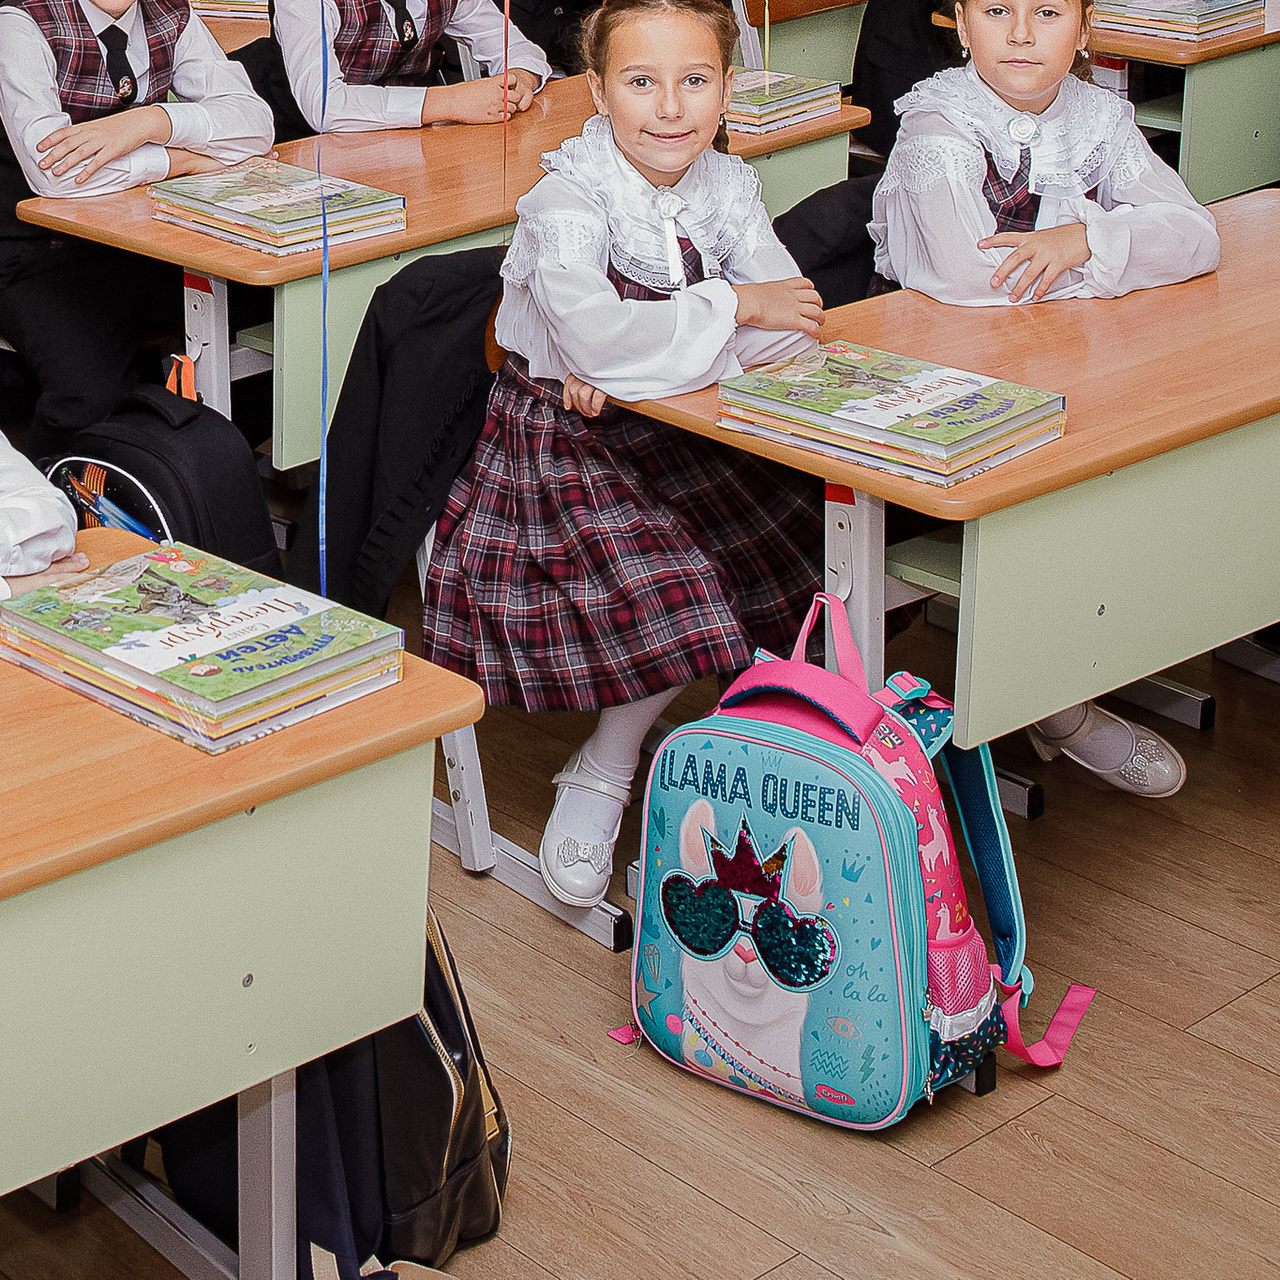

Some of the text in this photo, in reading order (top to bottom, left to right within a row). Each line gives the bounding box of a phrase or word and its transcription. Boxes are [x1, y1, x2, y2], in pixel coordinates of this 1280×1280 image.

[660, 749, 860, 831] LLAMA QUEEN
[846, 961, 869, 980] oh
[842, 981, 889, 1003] la la
